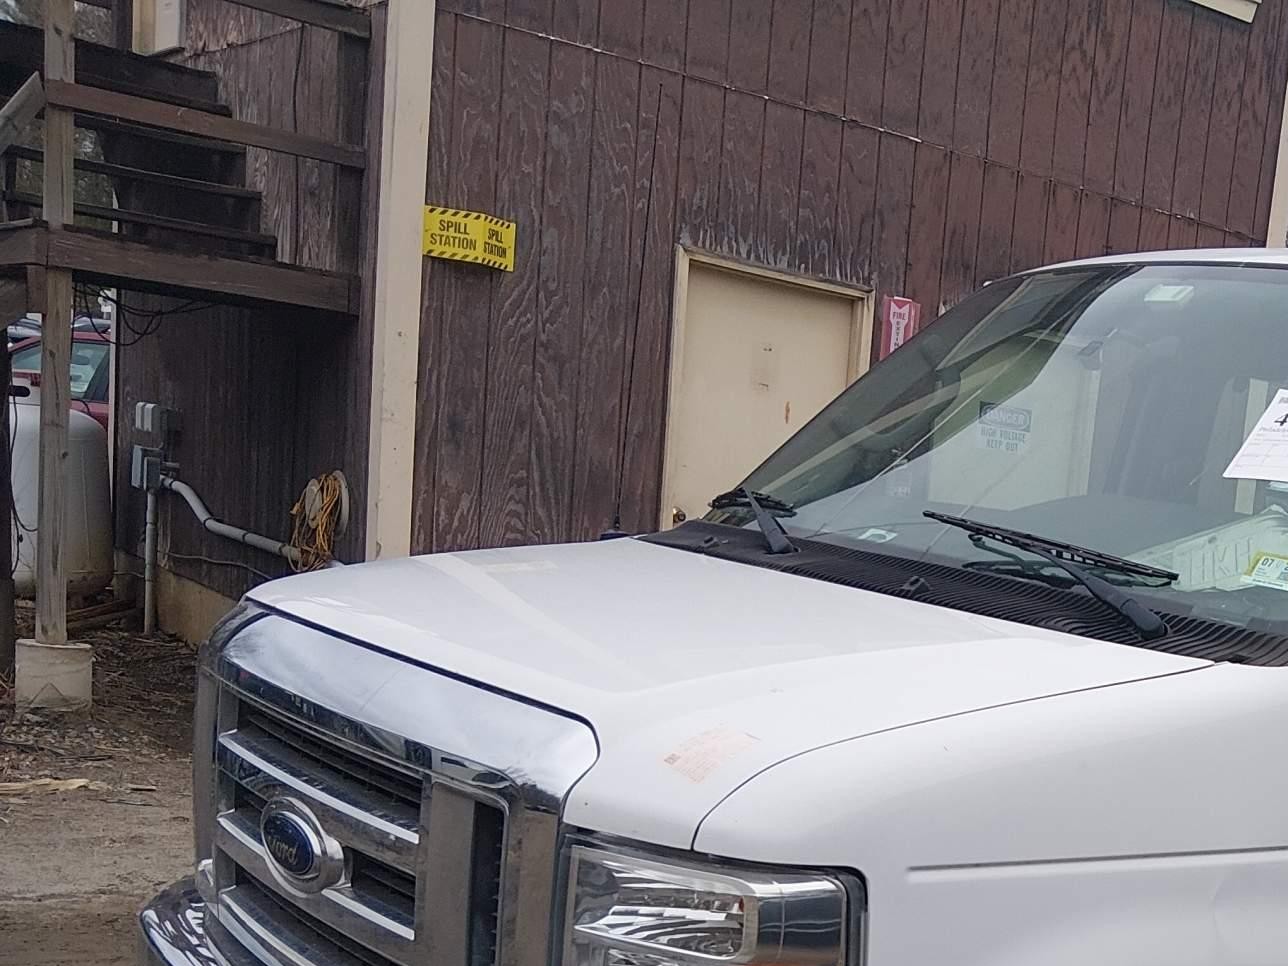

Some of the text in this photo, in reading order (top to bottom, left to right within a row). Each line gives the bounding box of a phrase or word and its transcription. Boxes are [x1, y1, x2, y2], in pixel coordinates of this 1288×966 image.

[439, 219, 470, 235] SPILL
[430, 232, 477, 251] STATION
[488, 228, 503, 244] SPILL
[483, 241, 507, 259] STATION
[892, 311, 907, 320] FIRE
[1261, 558, 1274, 567] 07
[266, 834, 299, 866] Ford
